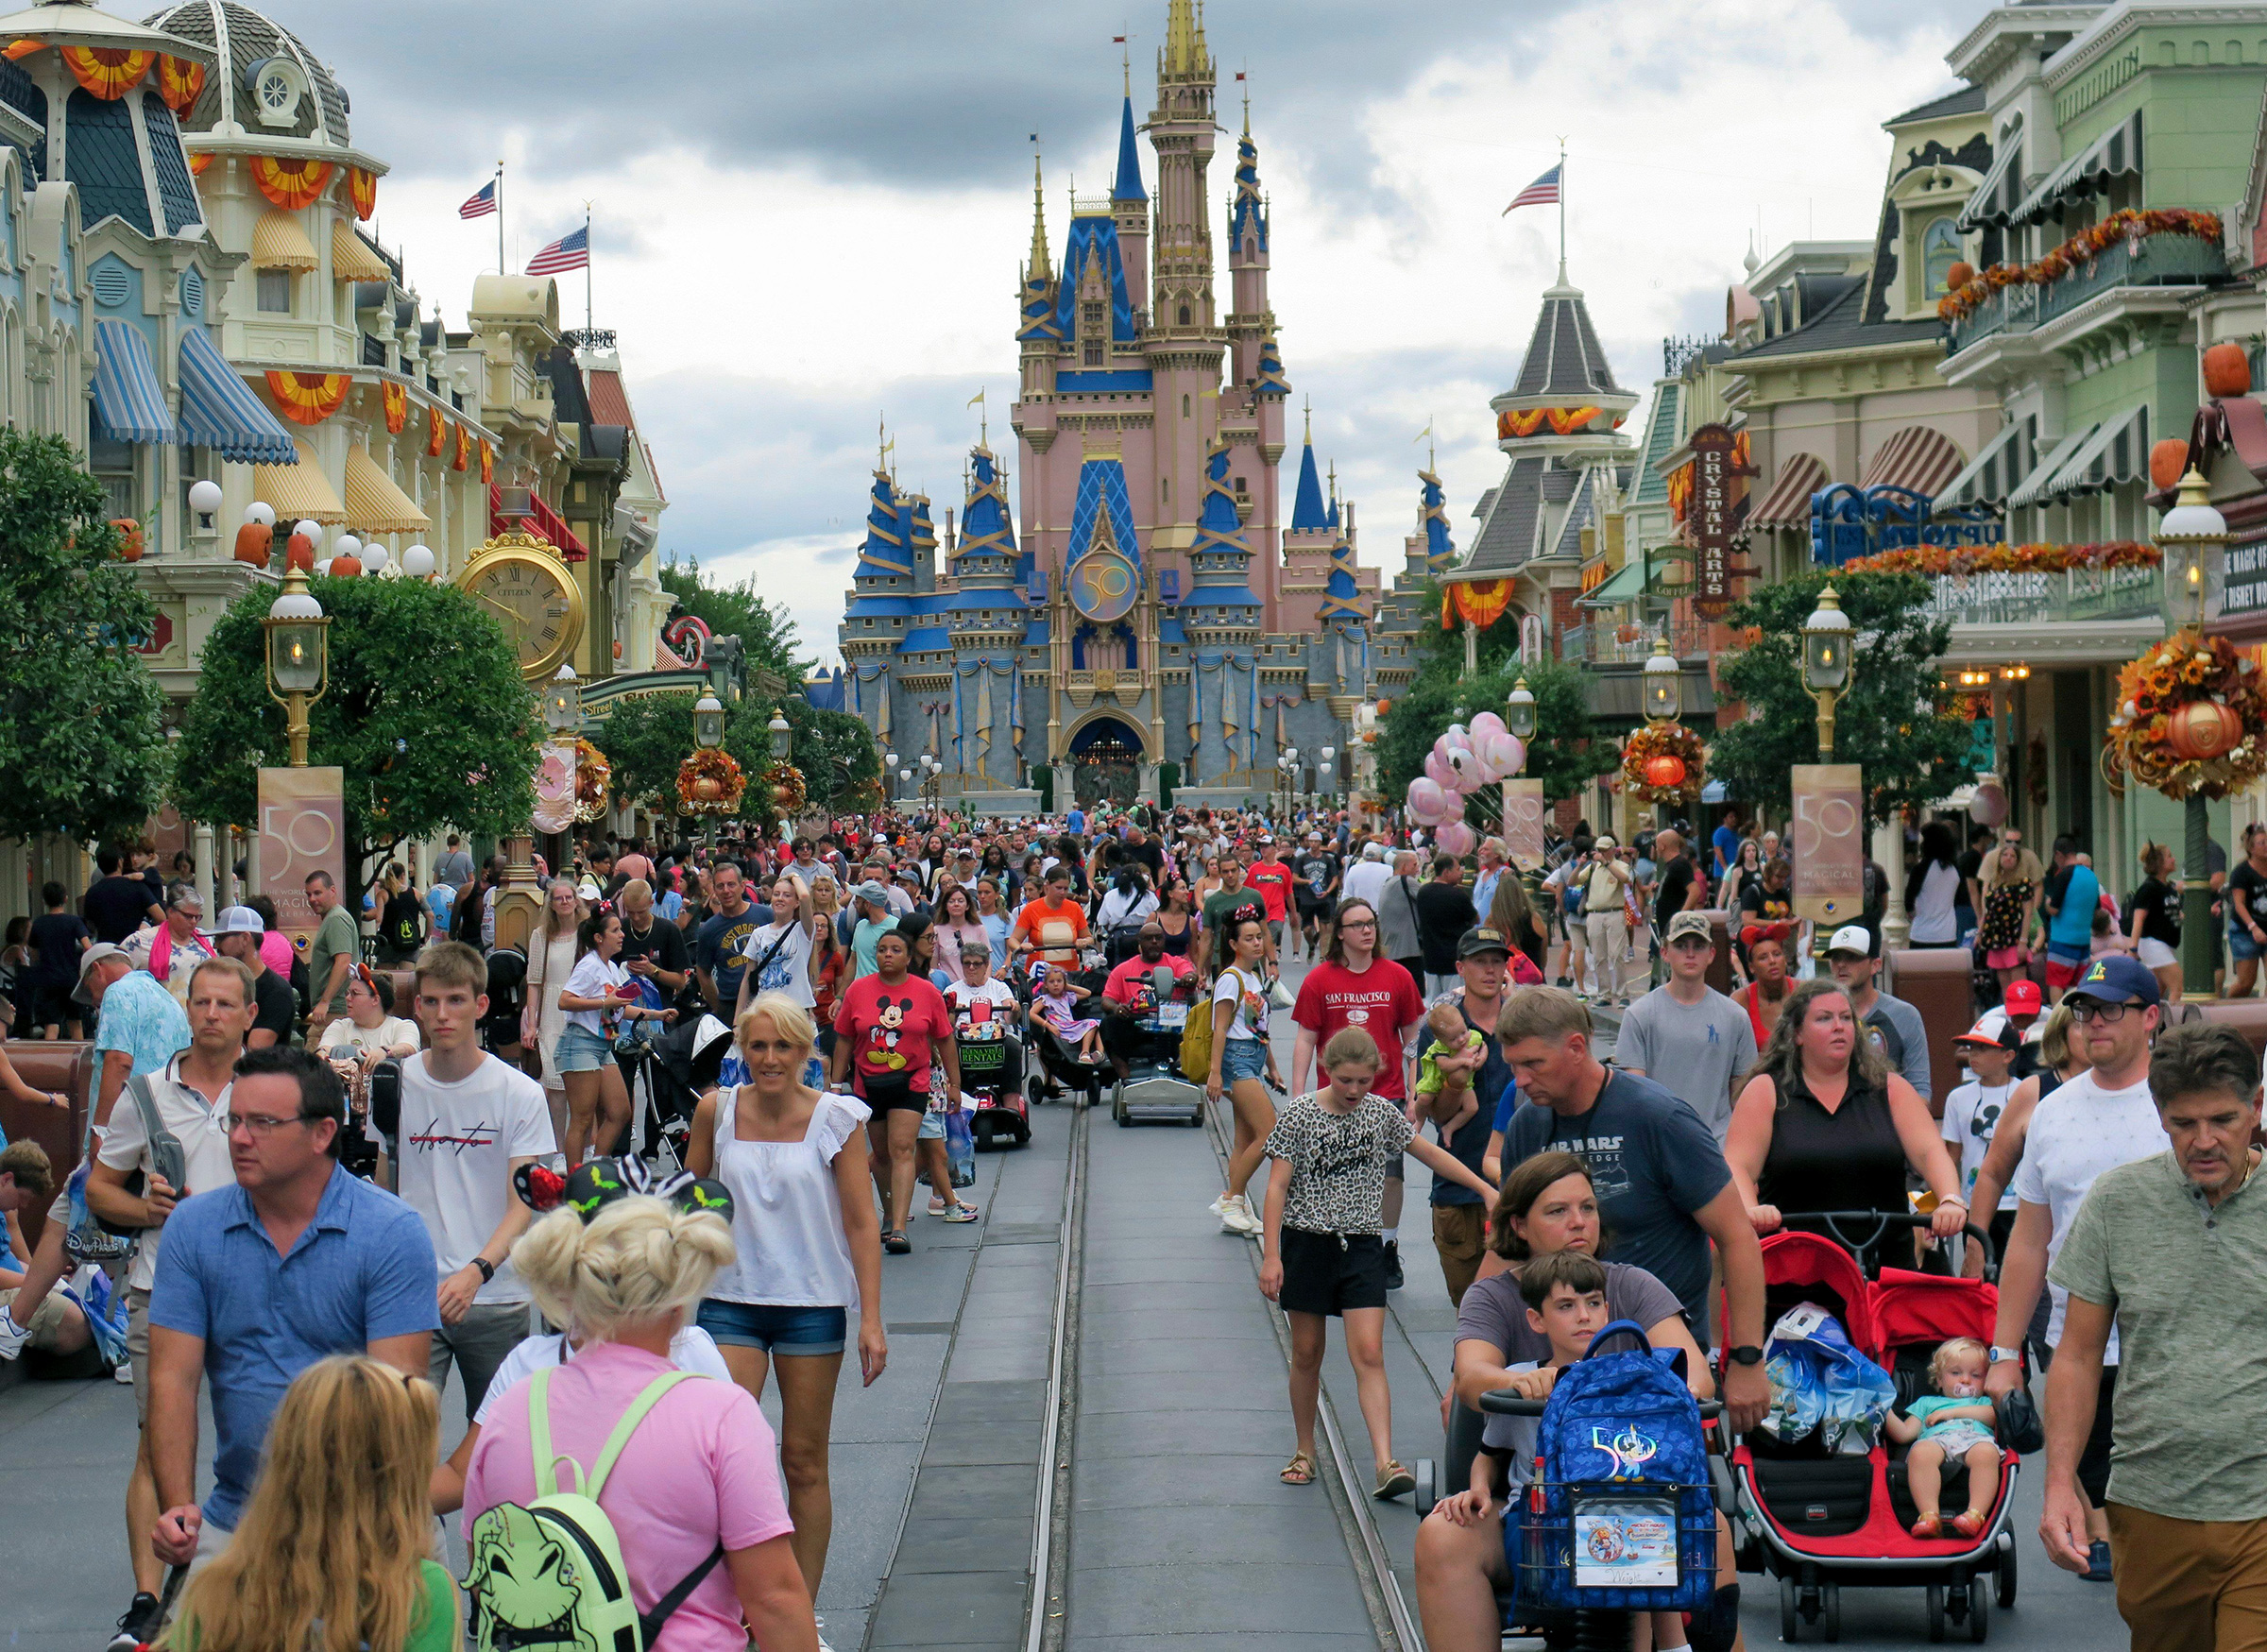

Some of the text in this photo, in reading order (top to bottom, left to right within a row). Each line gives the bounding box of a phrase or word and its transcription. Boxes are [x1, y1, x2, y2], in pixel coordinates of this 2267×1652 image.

[1705, 451, 1724, 595] CRYSTAL ARTS
[1084, 564, 1131, 614] 50
[2228, 583, 2255, 609] DISNEY
[585, 699, 613, 716] Street
[1799, 795, 1857, 857] 50
[264, 807, 335, 882] 50
[721, 929, 737, 949] WEST
[1325, 990, 1390, 1004] SAN FRANCISCO
[962, 1045, 1003, 1055] BUENA VISTA
[962, 1052, 1003, 1063] RENTALS
[1572, 1136, 1625, 1152] WARS
[1588, 1154, 1620, 1163] EDGE
